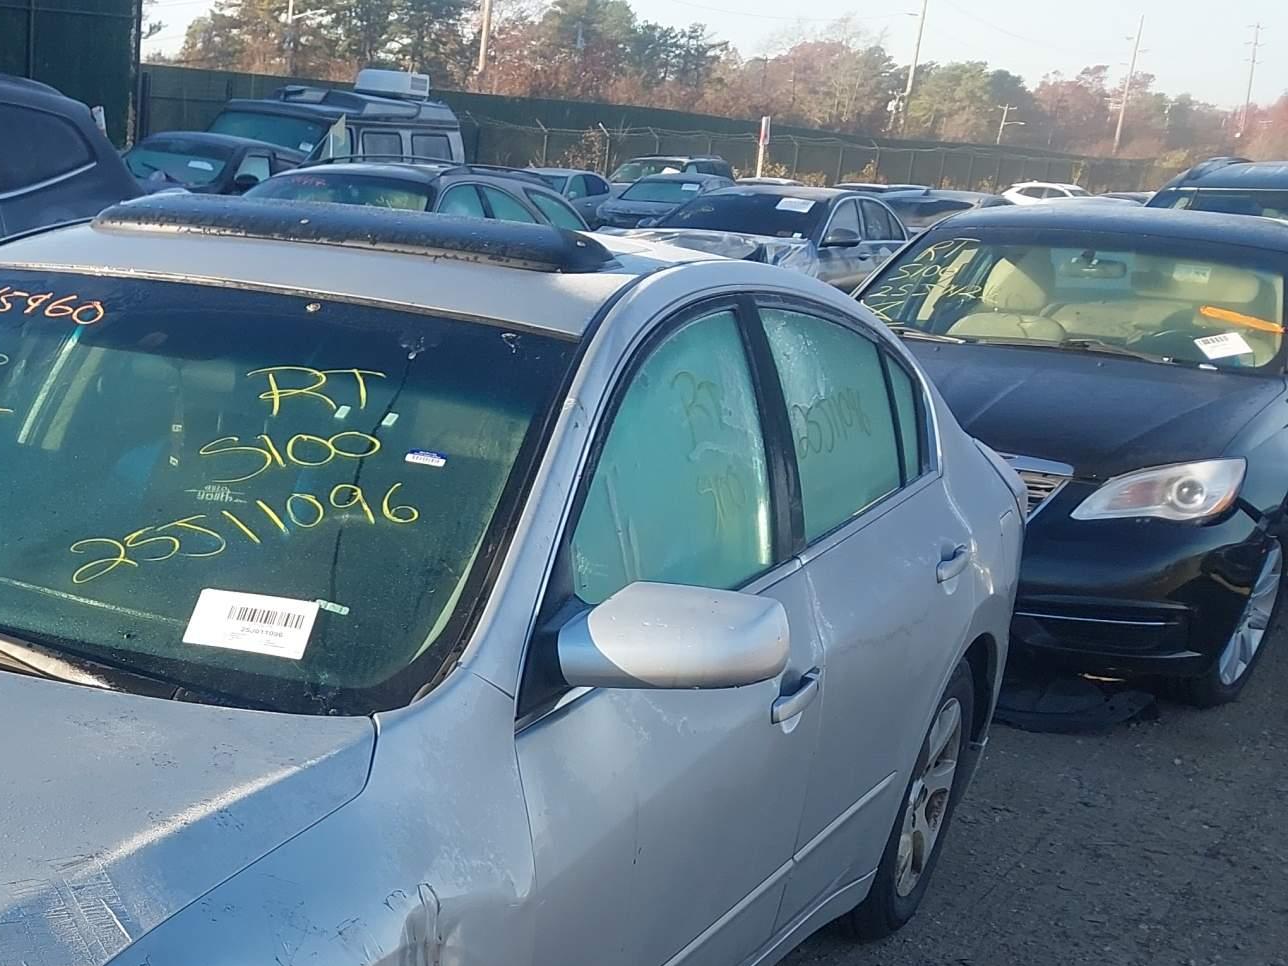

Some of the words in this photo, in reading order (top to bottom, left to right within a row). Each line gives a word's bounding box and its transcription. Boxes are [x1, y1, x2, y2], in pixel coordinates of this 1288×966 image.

[913, 237, 981, 262] RT
[247, 366, 386, 417] RT
[199, 431, 381, 483] S100
